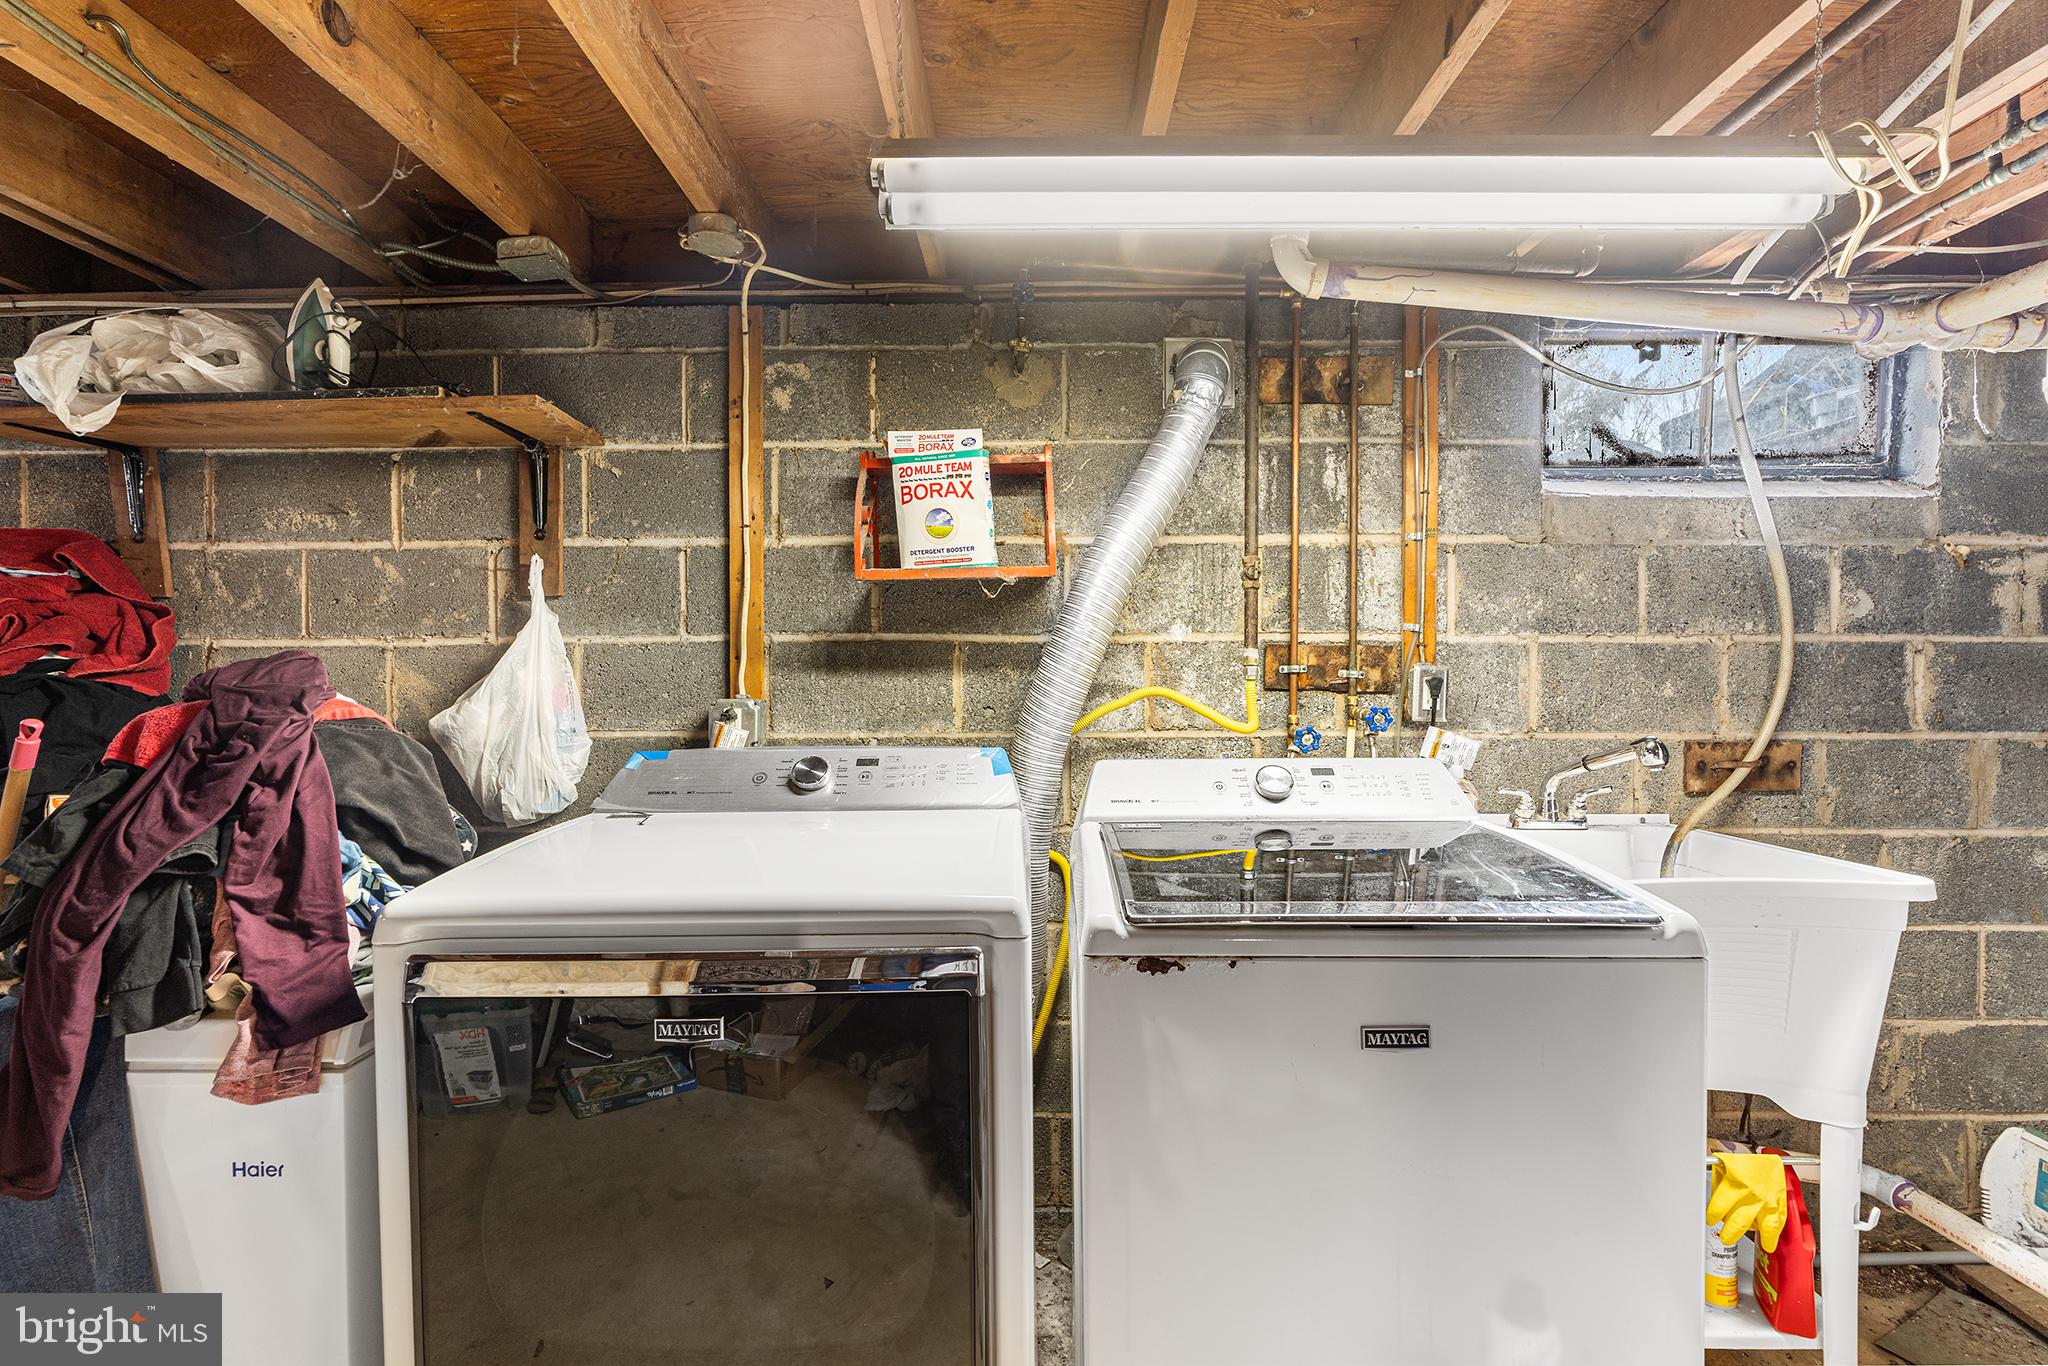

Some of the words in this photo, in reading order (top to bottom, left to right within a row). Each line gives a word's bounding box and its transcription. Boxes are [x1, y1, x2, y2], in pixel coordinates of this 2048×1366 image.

[918, 442, 954, 453] BORAX
[898, 466, 914, 479] 20
[914, 463, 944, 476] MULE
[944, 461, 972, 472] TEAM
[900, 480, 975, 506] BORAX
[910, 548, 945, 556] DETERGENT
[946, 546, 975, 554] BOOSTER
[658, 1023, 719, 1037] MAYTAG
[1367, 1032, 1427, 1045] MAYTAG
[232, 1161, 284, 1177] Haier
